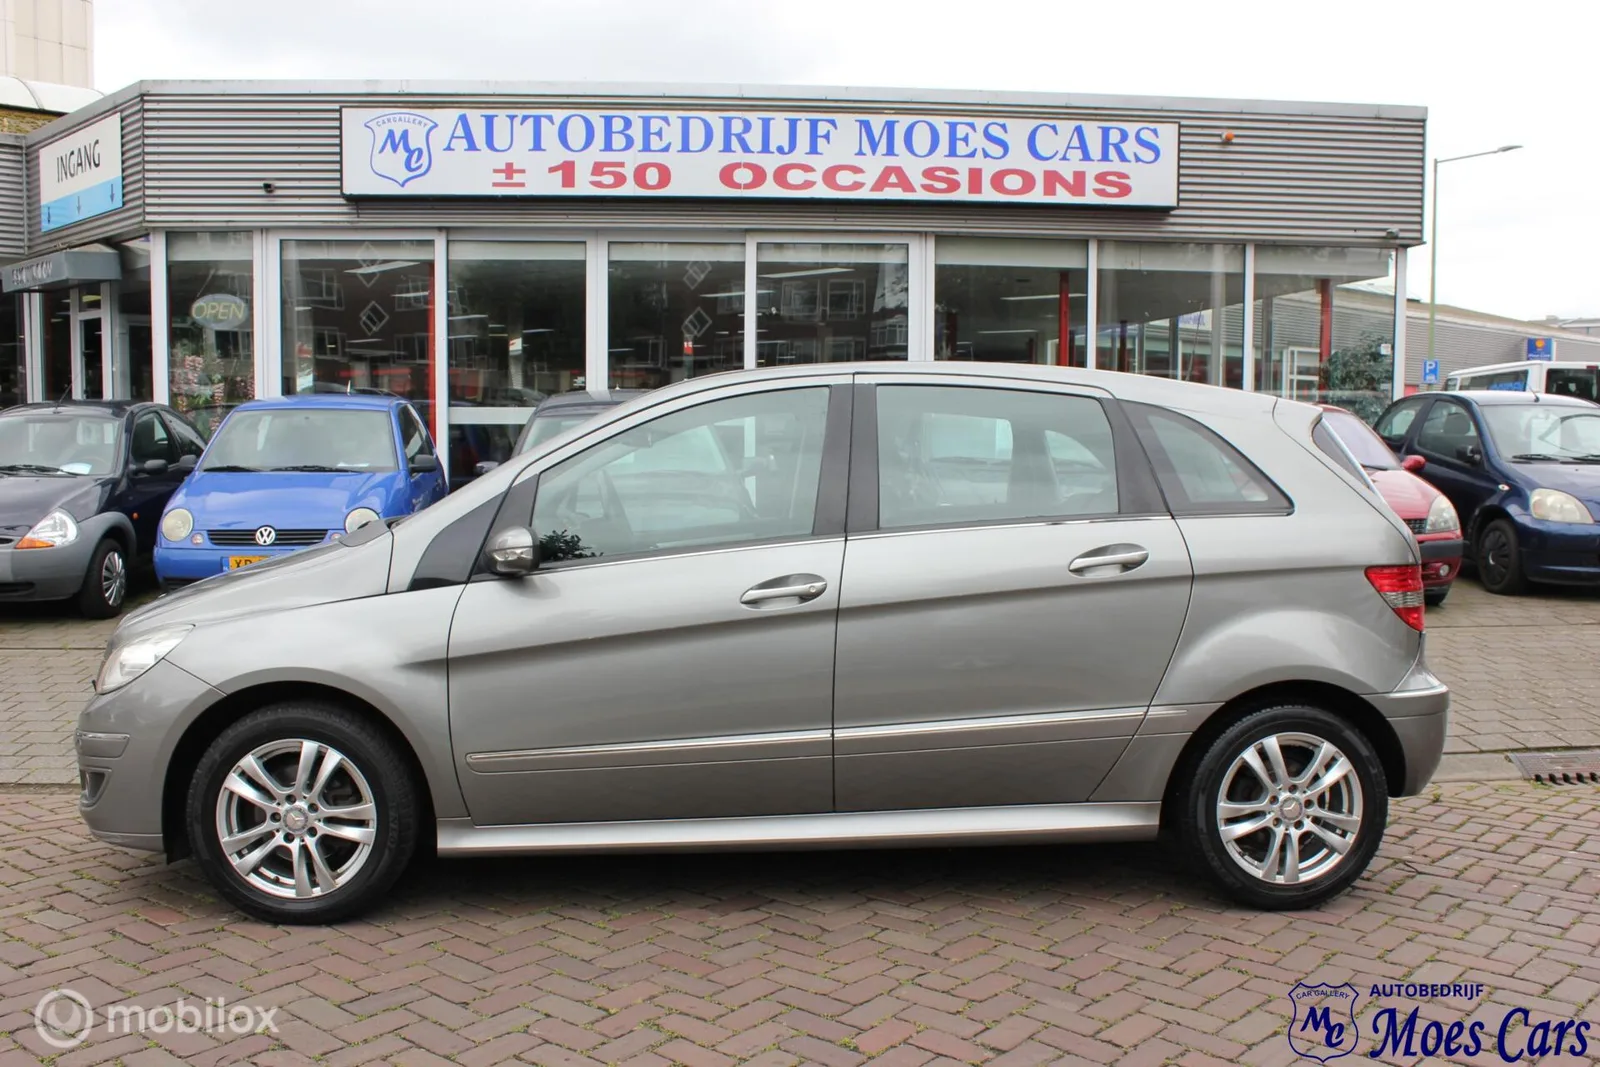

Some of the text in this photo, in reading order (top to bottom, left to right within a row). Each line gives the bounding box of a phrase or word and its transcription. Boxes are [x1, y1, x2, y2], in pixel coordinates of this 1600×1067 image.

[442, 113, 1161, 165] AUTOBEDRIJF MOES CARS
[56, 139, 101, 183] INGANG
[547, 161, 672, 190] 150
[718, 161, 1134, 198] OCCASIONS
[192, 302, 245, 320] OPEN
[1426, 362, 1436, 373] P
